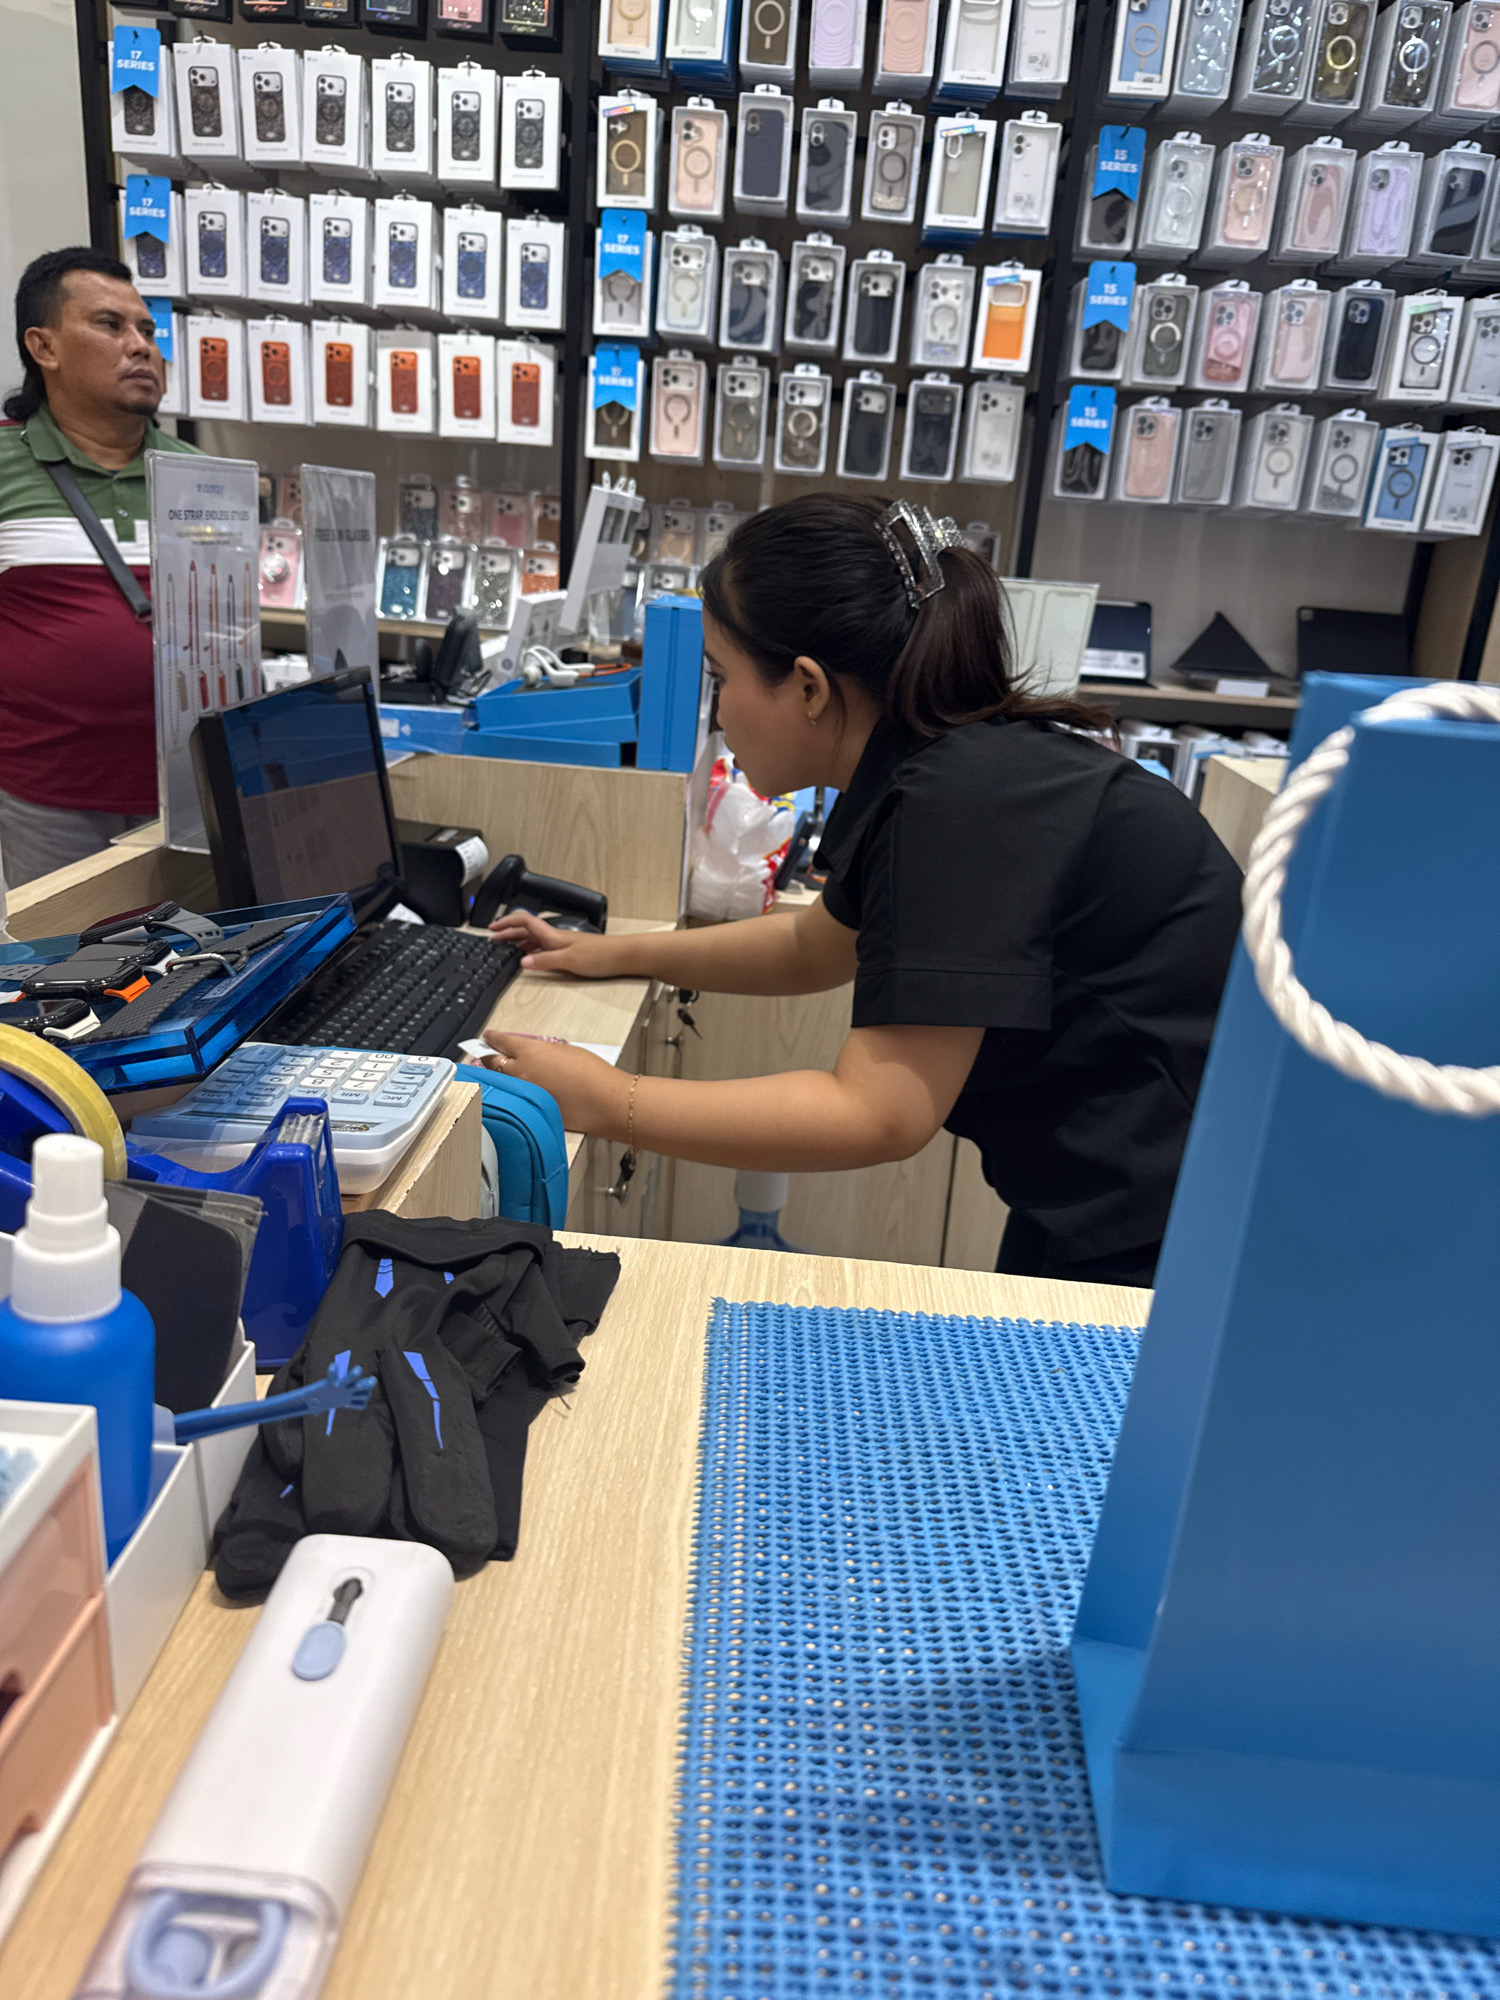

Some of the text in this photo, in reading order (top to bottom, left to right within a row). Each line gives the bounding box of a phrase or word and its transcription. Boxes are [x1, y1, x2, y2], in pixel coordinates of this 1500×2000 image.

[130, 50, 142, 60] 17
[117, 59, 155, 71] SERIES
[1114, 149, 1128, 161] 15
[1100, 161, 1138, 173] SERIES
[142, 197, 153, 207] 17
[129, 206, 166, 218] SERIES
[617, 233, 629, 244] 17
[604, 243, 640, 255] SERIES
[1104, 283, 1118, 294] 15
[1090, 295, 1128, 306] SERIES
[598, 375, 634, 387] SERIES
[1084, 406, 1098, 418] 15
[1071, 416, 1108, 429] SERIES
[168, 509, 182, 521] ONE
[205, 510, 229, 521] ENDLESS
[230, 510, 249, 521] STYLES
